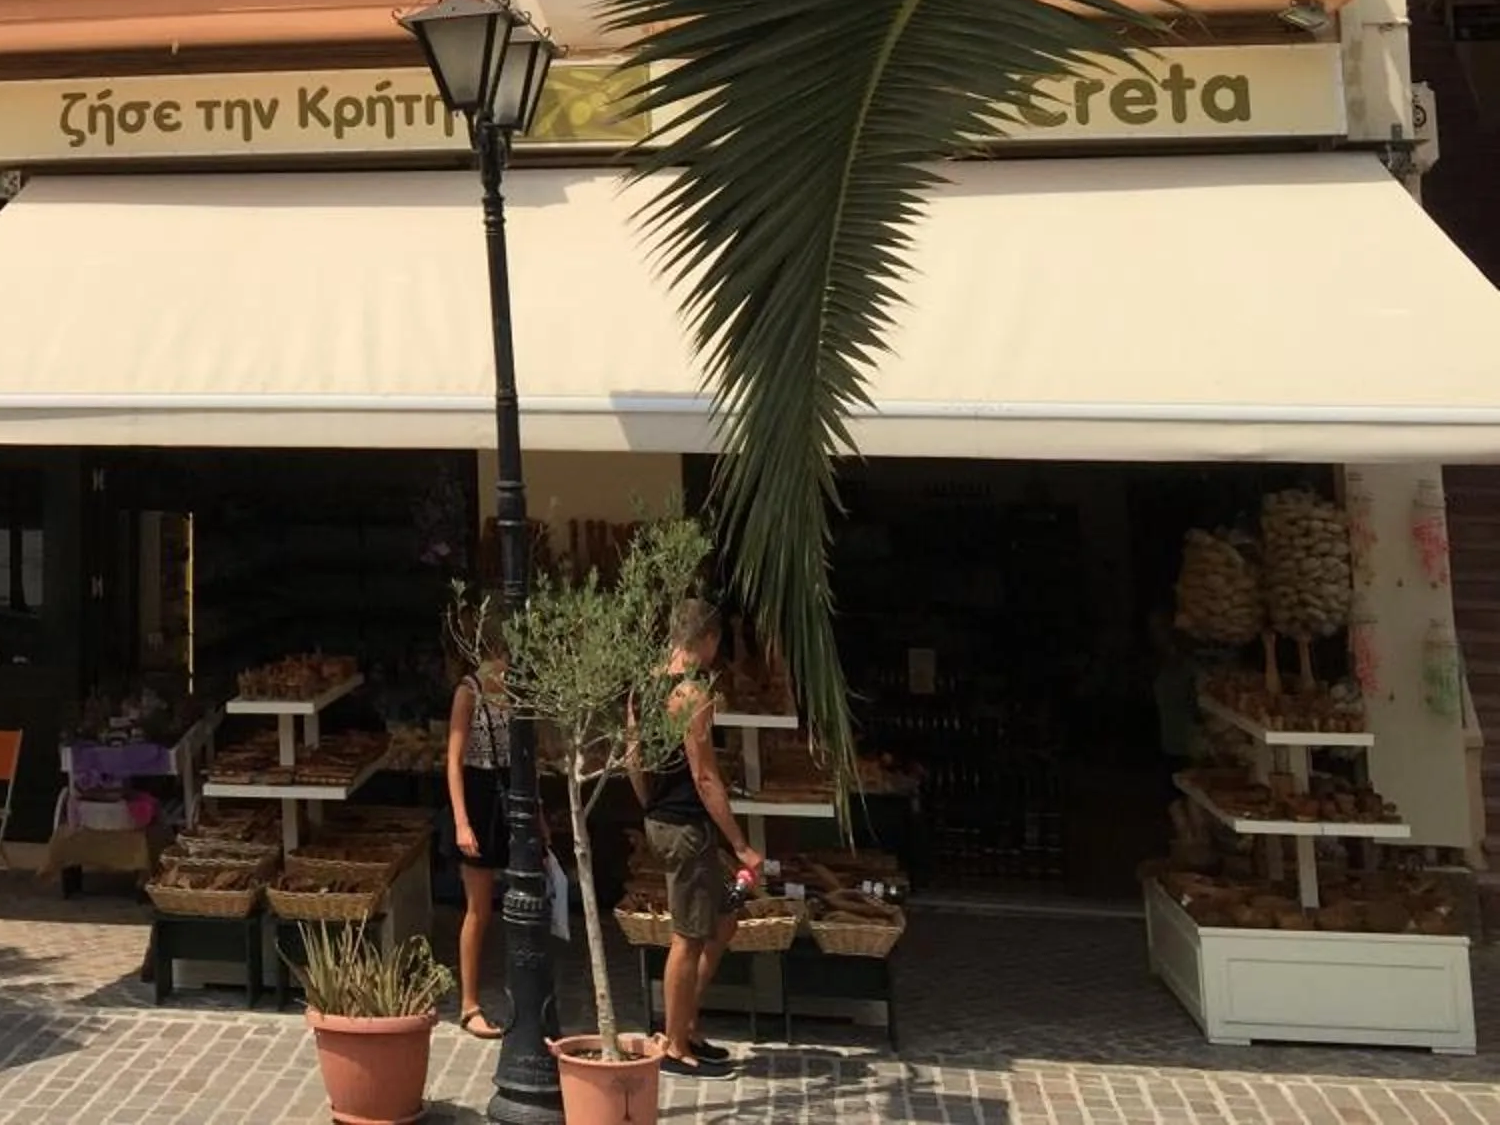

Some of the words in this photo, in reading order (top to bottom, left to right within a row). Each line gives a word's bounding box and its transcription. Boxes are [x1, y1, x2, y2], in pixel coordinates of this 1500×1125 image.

[60, 89, 183, 148] ζήσε
[196, 97, 280, 142] την
[297, 80, 454, 139] Κρήτη
